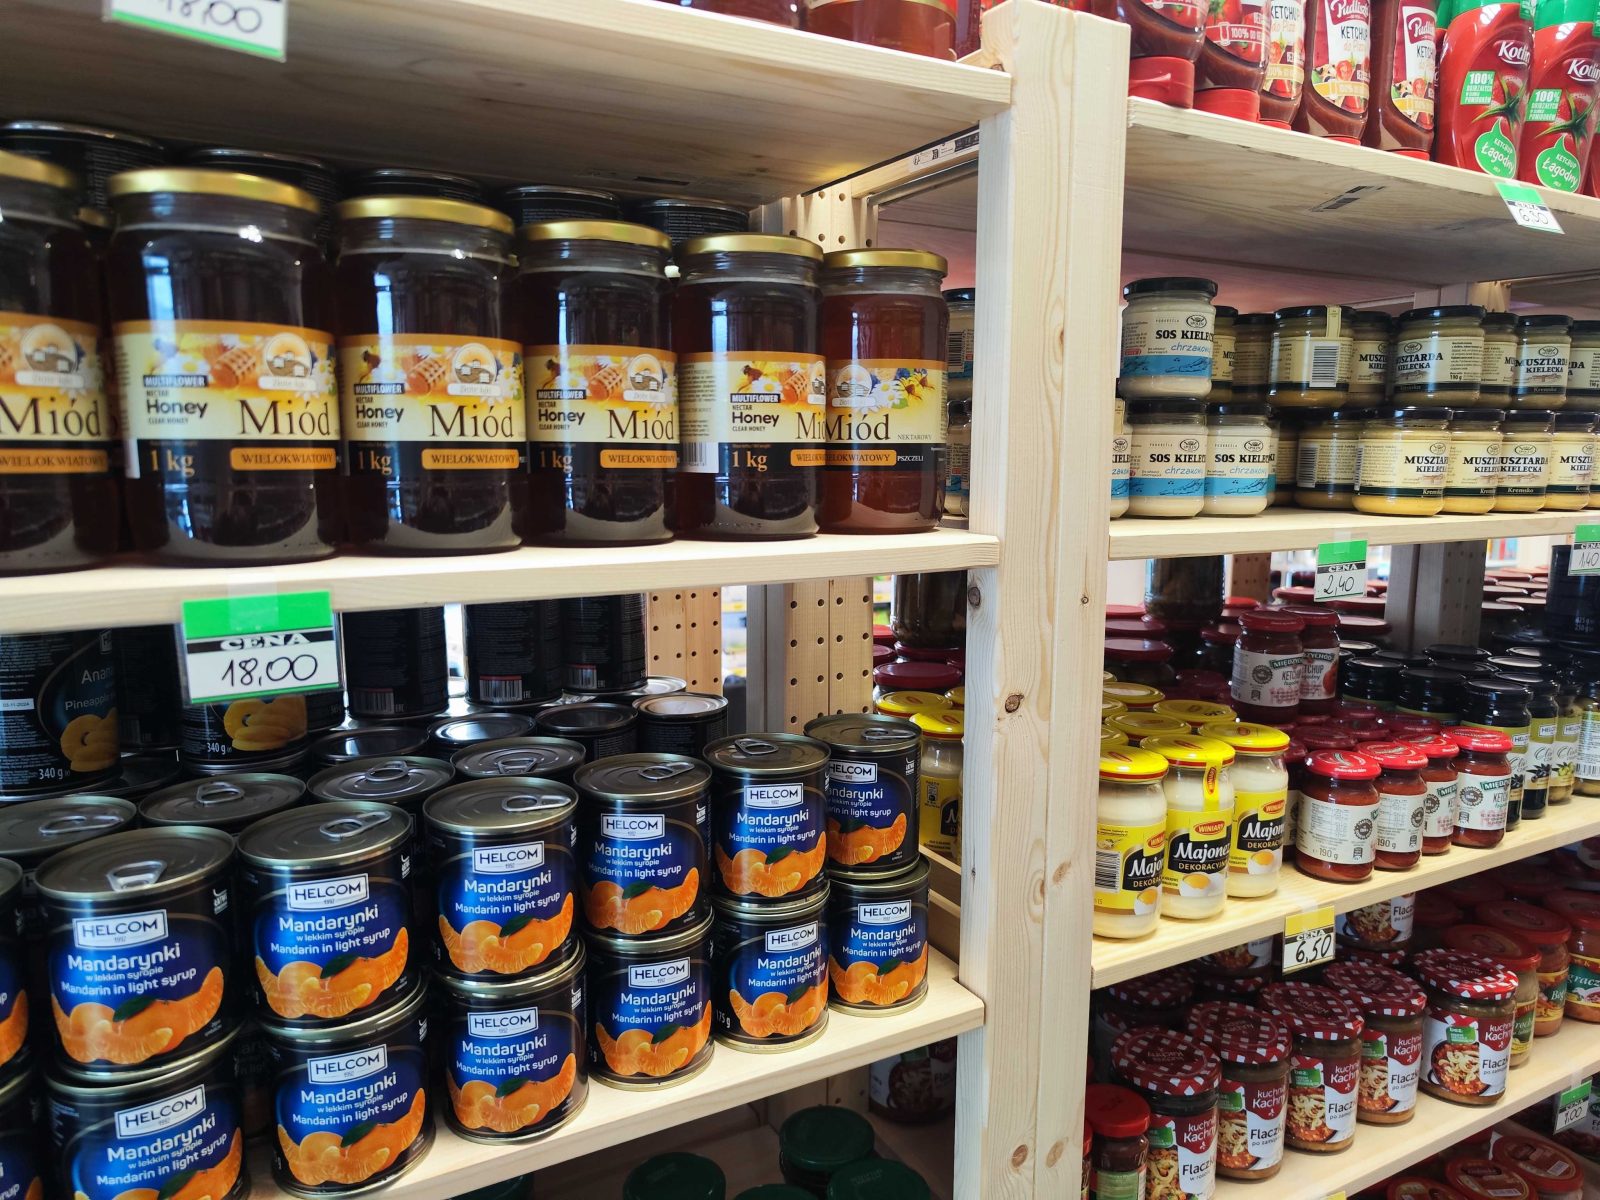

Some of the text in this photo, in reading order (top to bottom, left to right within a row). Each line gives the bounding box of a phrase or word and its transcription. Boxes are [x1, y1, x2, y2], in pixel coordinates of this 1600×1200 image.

[1498, 39, 1531, 62] Kotlin
[1481, 142, 1515, 174] Łagodny
[1542, 156, 1578, 189] Łagodny
[1155, 329, 1177, 340] SOS
[145, 376, 206, 386] MULTIFLOWER
[356, 384, 402, 394] MULTIFLOWER
[538, 390, 584, 399] MULTIFLOWER
[730, 394, 780, 403] MULTIFLOWER
[0, 397, 101, 437] Miód
[147, 399, 208, 418] Honey
[239, 400, 330, 436] Miód
[356, 405, 404, 422] Honey
[538, 409, 585, 426] Honey
[428, 403, 514, 437] Miód
[605, 408, 675, 440] Miód
[732, 411, 780, 427] Honey
[826, 413, 890, 440] Miód
[151, 448, 196, 477] 1 kg
[242, 454, 333, 465] WIELOKWIATOWY
[359, 450, 393, 475] 1 kg
[431, 453, 516, 464] WIELOKWIATOWY
[541, 449, 574, 473] 1 kg
[607, 454, 677, 464] WIELOKWIATOWY
[732, 450, 768, 473] 1 kg
[825, 453, 890, 462] IELOKWIATOWY
[1149, 453, 1171, 463] SOS
[1214, 453, 1235, 463] SOS
[1500, 456, 1548, 465] USZTARDA
[1500, 465, 1542, 473] KIELECKA
[1328, 564, 1358, 573] CENA
[1324, 575, 1354, 595] 2,40
[220, 633, 311, 651] CENA
[221, 654, 318, 688] 18,00
[206, 742, 227, 754] 340 g
[38, 768, 64, 780] 340 g
[750, 788, 798, 800] HELCOM
[606, 818, 658, 830] HELCOM
[737, 808, 809, 827] Mandarynki
[729, 829, 816, 845] Mandarin in light syrup
[1198, 823, 1223, 833] WINIARY
[595, 841, 672, 860] Mandarynki
[1377, 838, 1391, 848] 190
[480, 848, 538, 864] HELCOM
[1319, 848, 1339, 861] 190 g
[294, 881, 361, 900] HELCOM
[464, 870, 552, 894] Mandarynki
[455, 892, 561, 914] Mandarin in light syrup
[863, 905, 907, 917] HELCOM
[279, 904, 379, 932] Mandarynki
[82, 918, 158, 938] HELCOM
[305, 933, 333, 941] lekkim
[334, 925, 365, 939] syropie
[771, 927, 815, 945] HELCOM
[851, 922, 916, 941] Mandarynki
[270, 927, 391, 954] Mandarin in light syrup
[1296, 934, 1332, 963] 6,50
[67, 942, 181, 972] Mandarynki
[757, 944, 822, 970] Mandarynki
[61, 966, 197, 995] Mandarin in light syrup
[634, 963, 685, 979] HELCOM
[621, 981, 696, 1006] Mandarynki
[474, 1014, 531, 1029] HELCOM
[725, 1017, 731, 1029] g
[461, 1033, 547, 1057] Mandarynki
[316, 1052, 380, 1075] HELCOM
[300, 1071, 397, 1105] Mandarynki
[125, 1094, 198, 1128] HELCOM
[107, 1112, 216, 1163] Mandarynki
